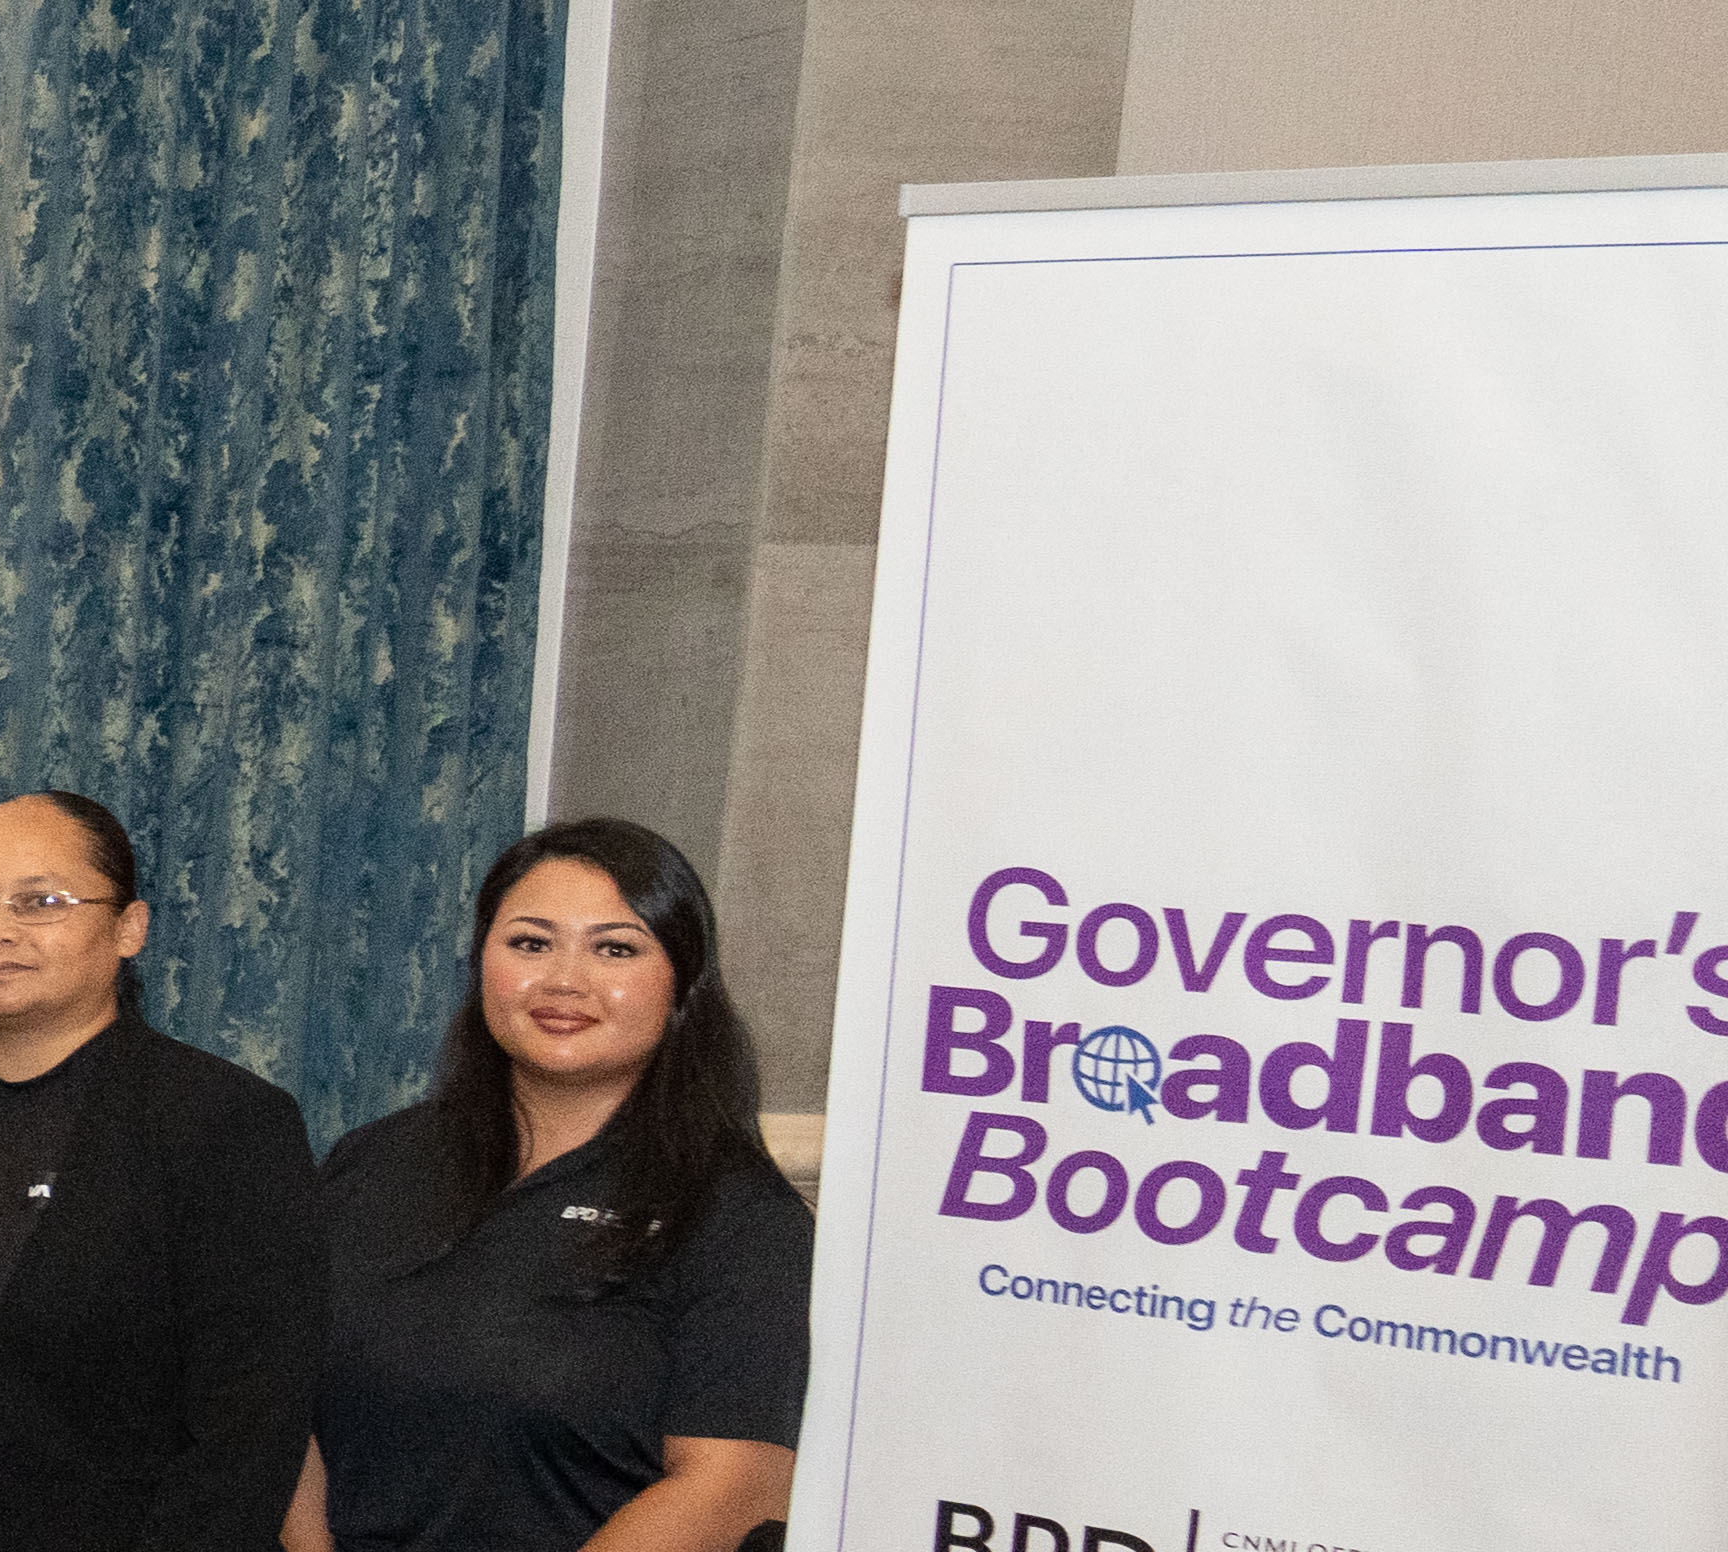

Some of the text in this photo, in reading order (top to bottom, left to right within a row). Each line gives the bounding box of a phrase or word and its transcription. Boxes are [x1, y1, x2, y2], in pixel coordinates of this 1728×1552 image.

[937, 1110, 1728, 1328] Bootcamp
[978, 1263, 1683, 1385] Connecting the Commonwealth
